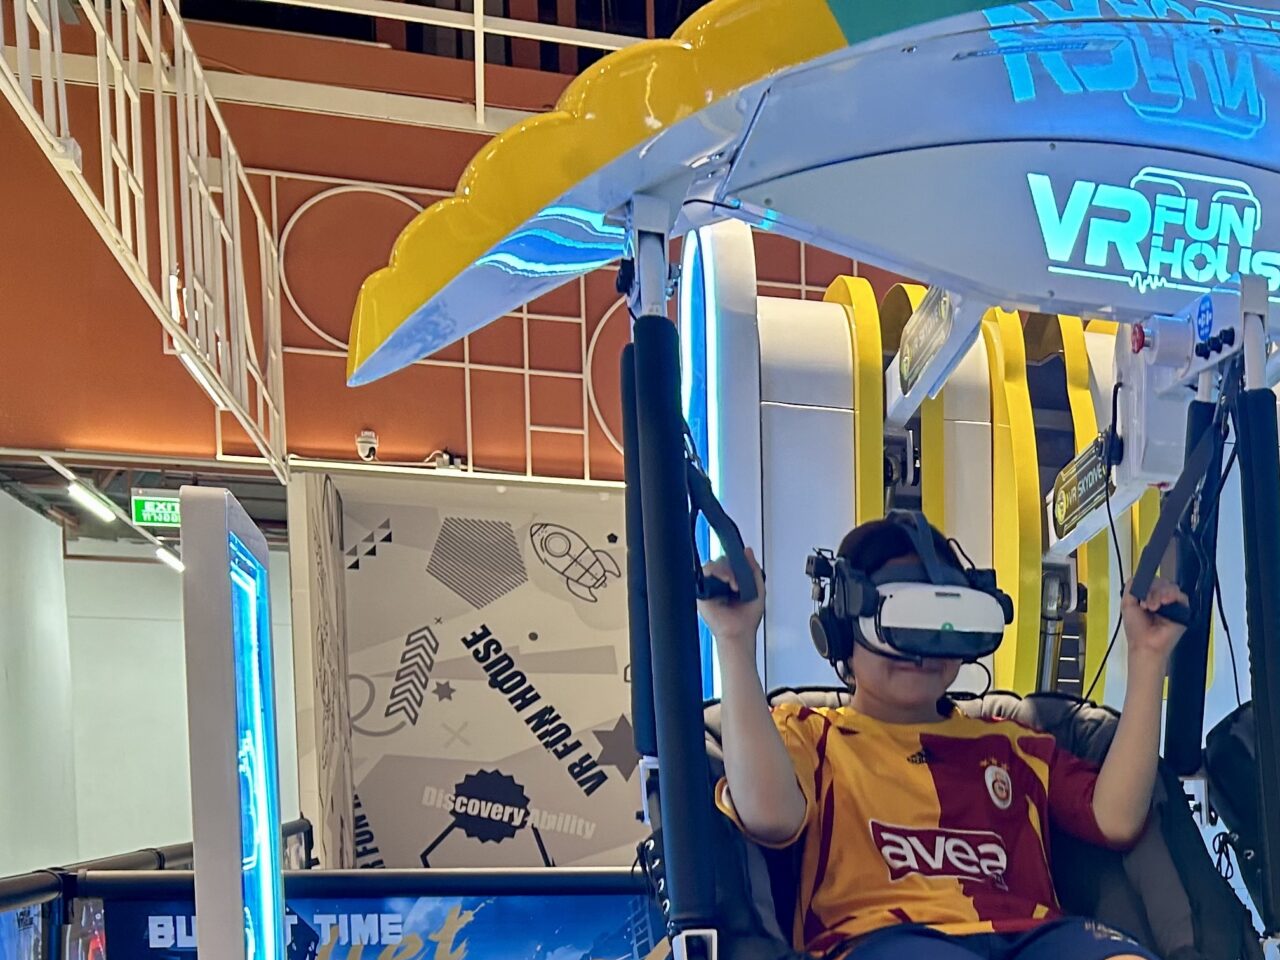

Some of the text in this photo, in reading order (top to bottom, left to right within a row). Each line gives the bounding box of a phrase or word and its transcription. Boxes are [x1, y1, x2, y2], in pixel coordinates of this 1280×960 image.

[1026, 172, 1152, 273] VR
[1151, 193, 1256, 247] FUN
[144, 501, 180, 512] EXIT
[460, 624, 608, 797] VR FUN HOUSE
[422, 785, 597, 840] Discovery Ability
[880, 832, 1007, 876] avea
[313, 913, 402, 947] TIME
